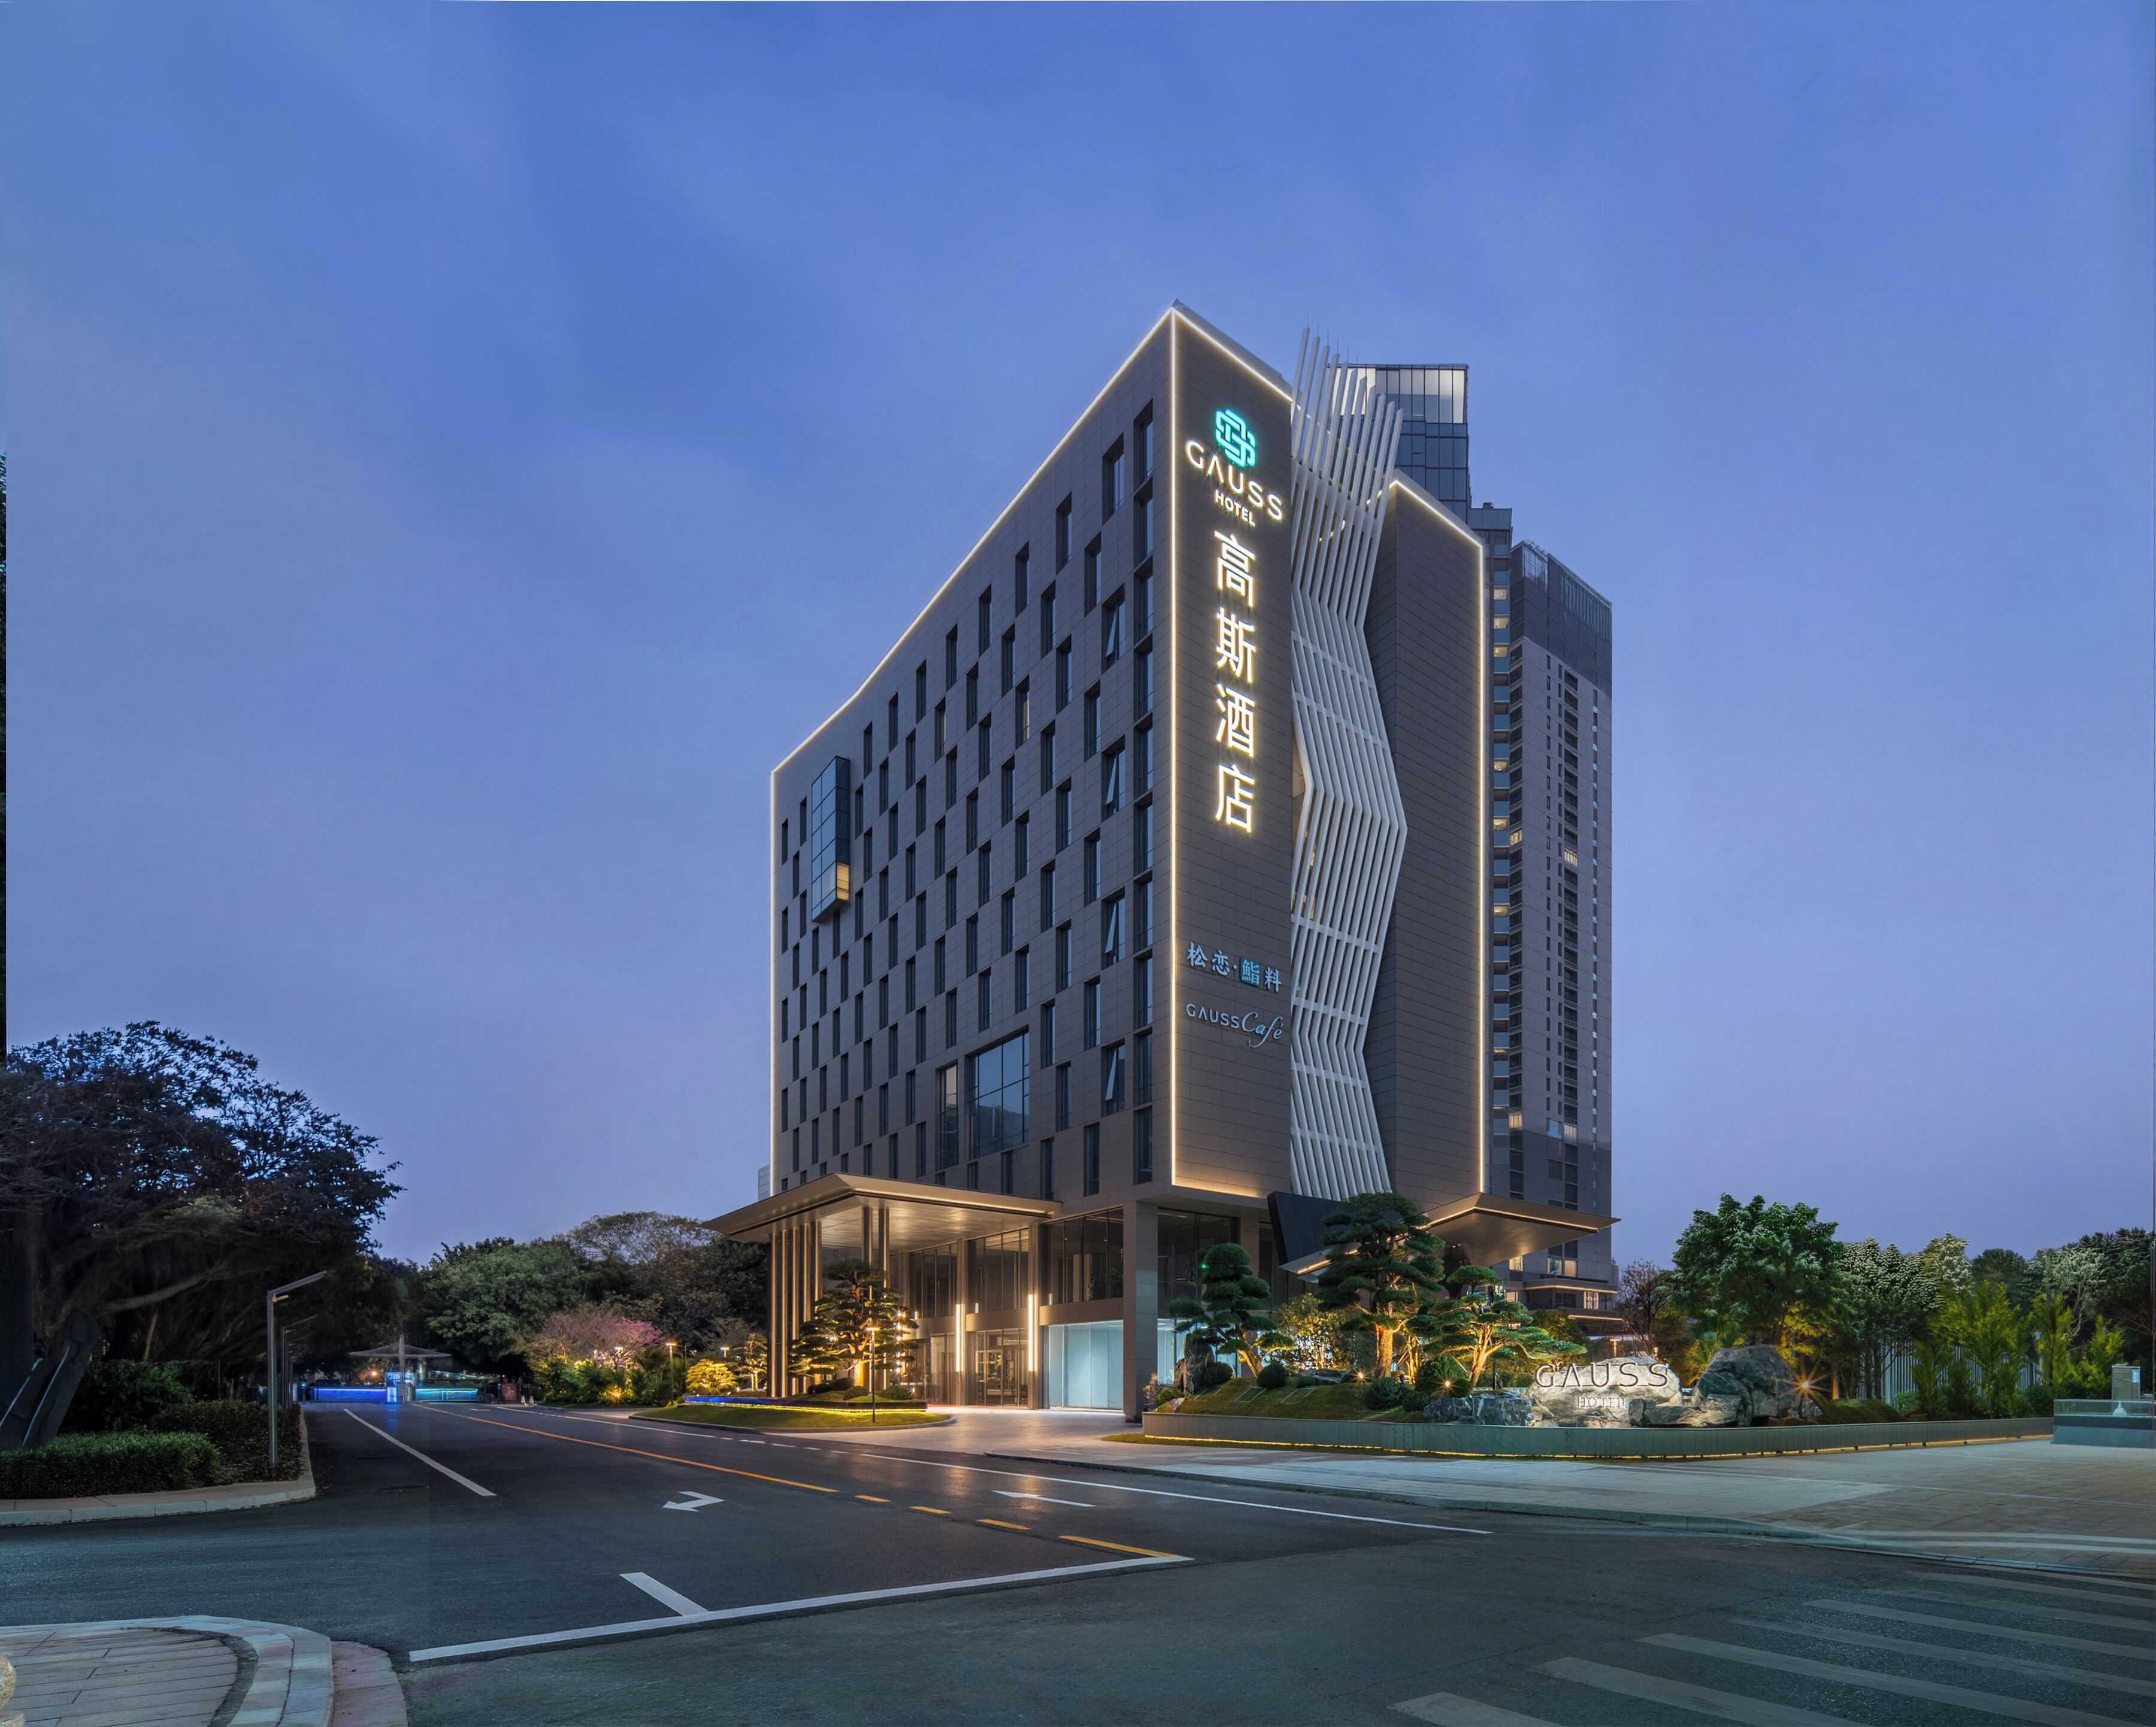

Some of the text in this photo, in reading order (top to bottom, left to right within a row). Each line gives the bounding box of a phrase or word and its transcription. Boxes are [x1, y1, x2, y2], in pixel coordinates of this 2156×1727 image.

[1185, 440, 1283, 521] GAUSS
[1215, 488, 1256, 527] HOTEL
[1214, 529, 1256, 834] 高斯酒店
[1535, 1362, 1670, 1388] GAUSS
[1576, 1397, 1627, 1408] HOTEL
